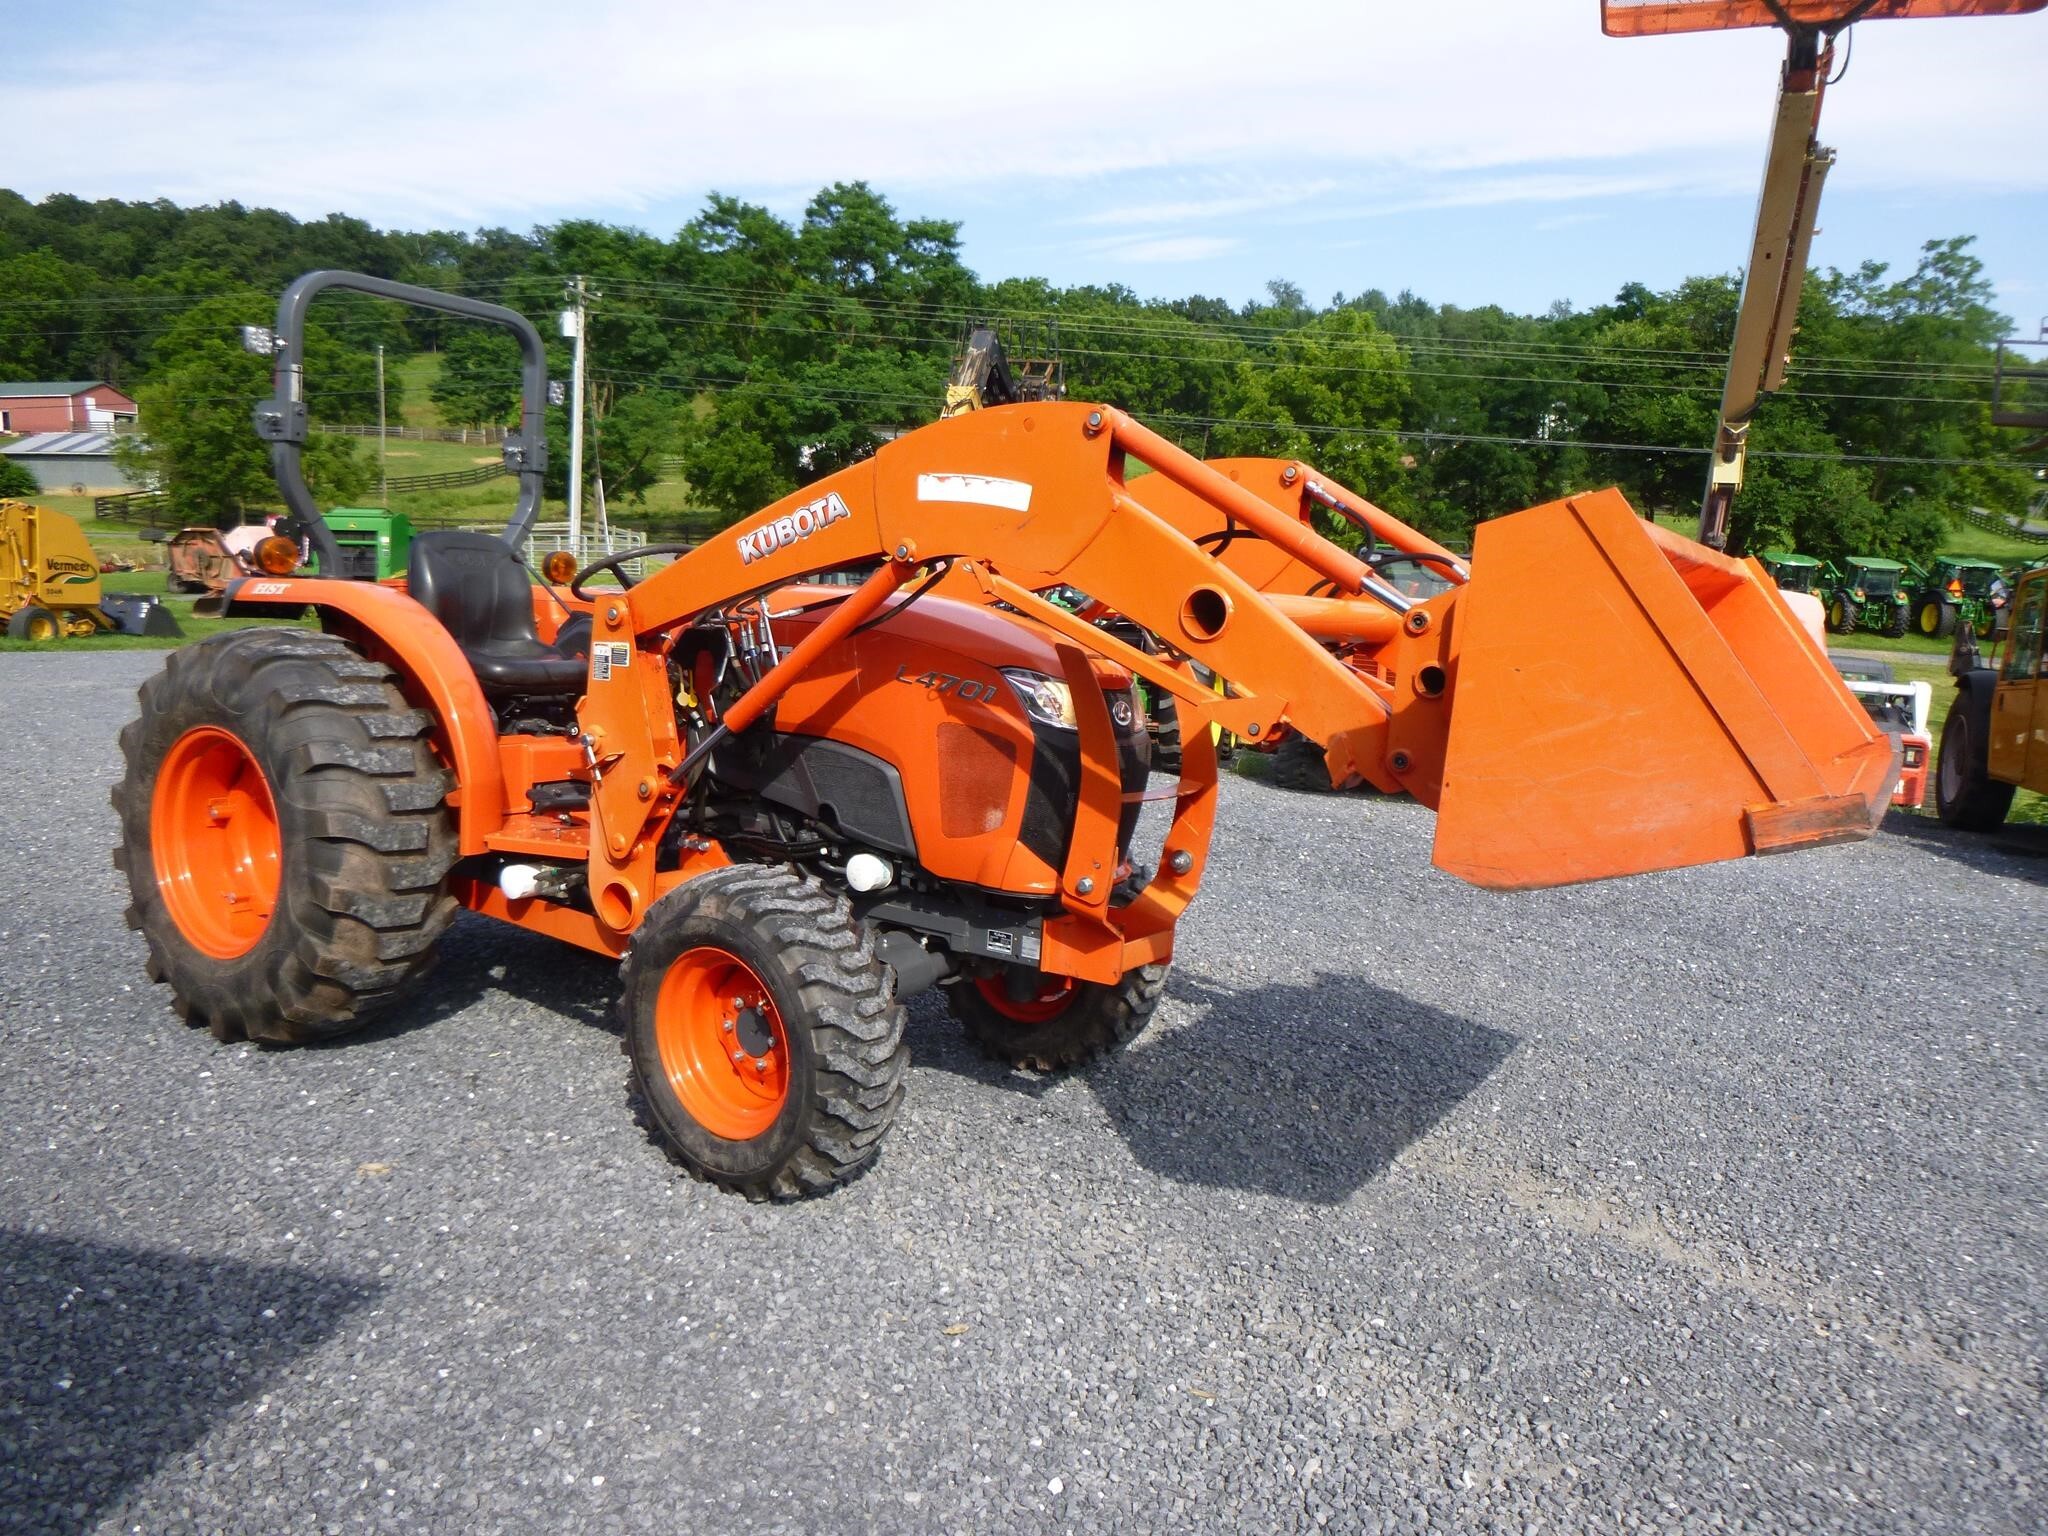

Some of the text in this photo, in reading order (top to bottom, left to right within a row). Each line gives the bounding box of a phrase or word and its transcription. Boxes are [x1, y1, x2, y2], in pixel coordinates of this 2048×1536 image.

[738, 492, 850, 566] KUBOTA
[46, 558, 90, 571] Vermeer
[252, 583, 292, 595] HST
[896, 664, 997, 703] L4701
